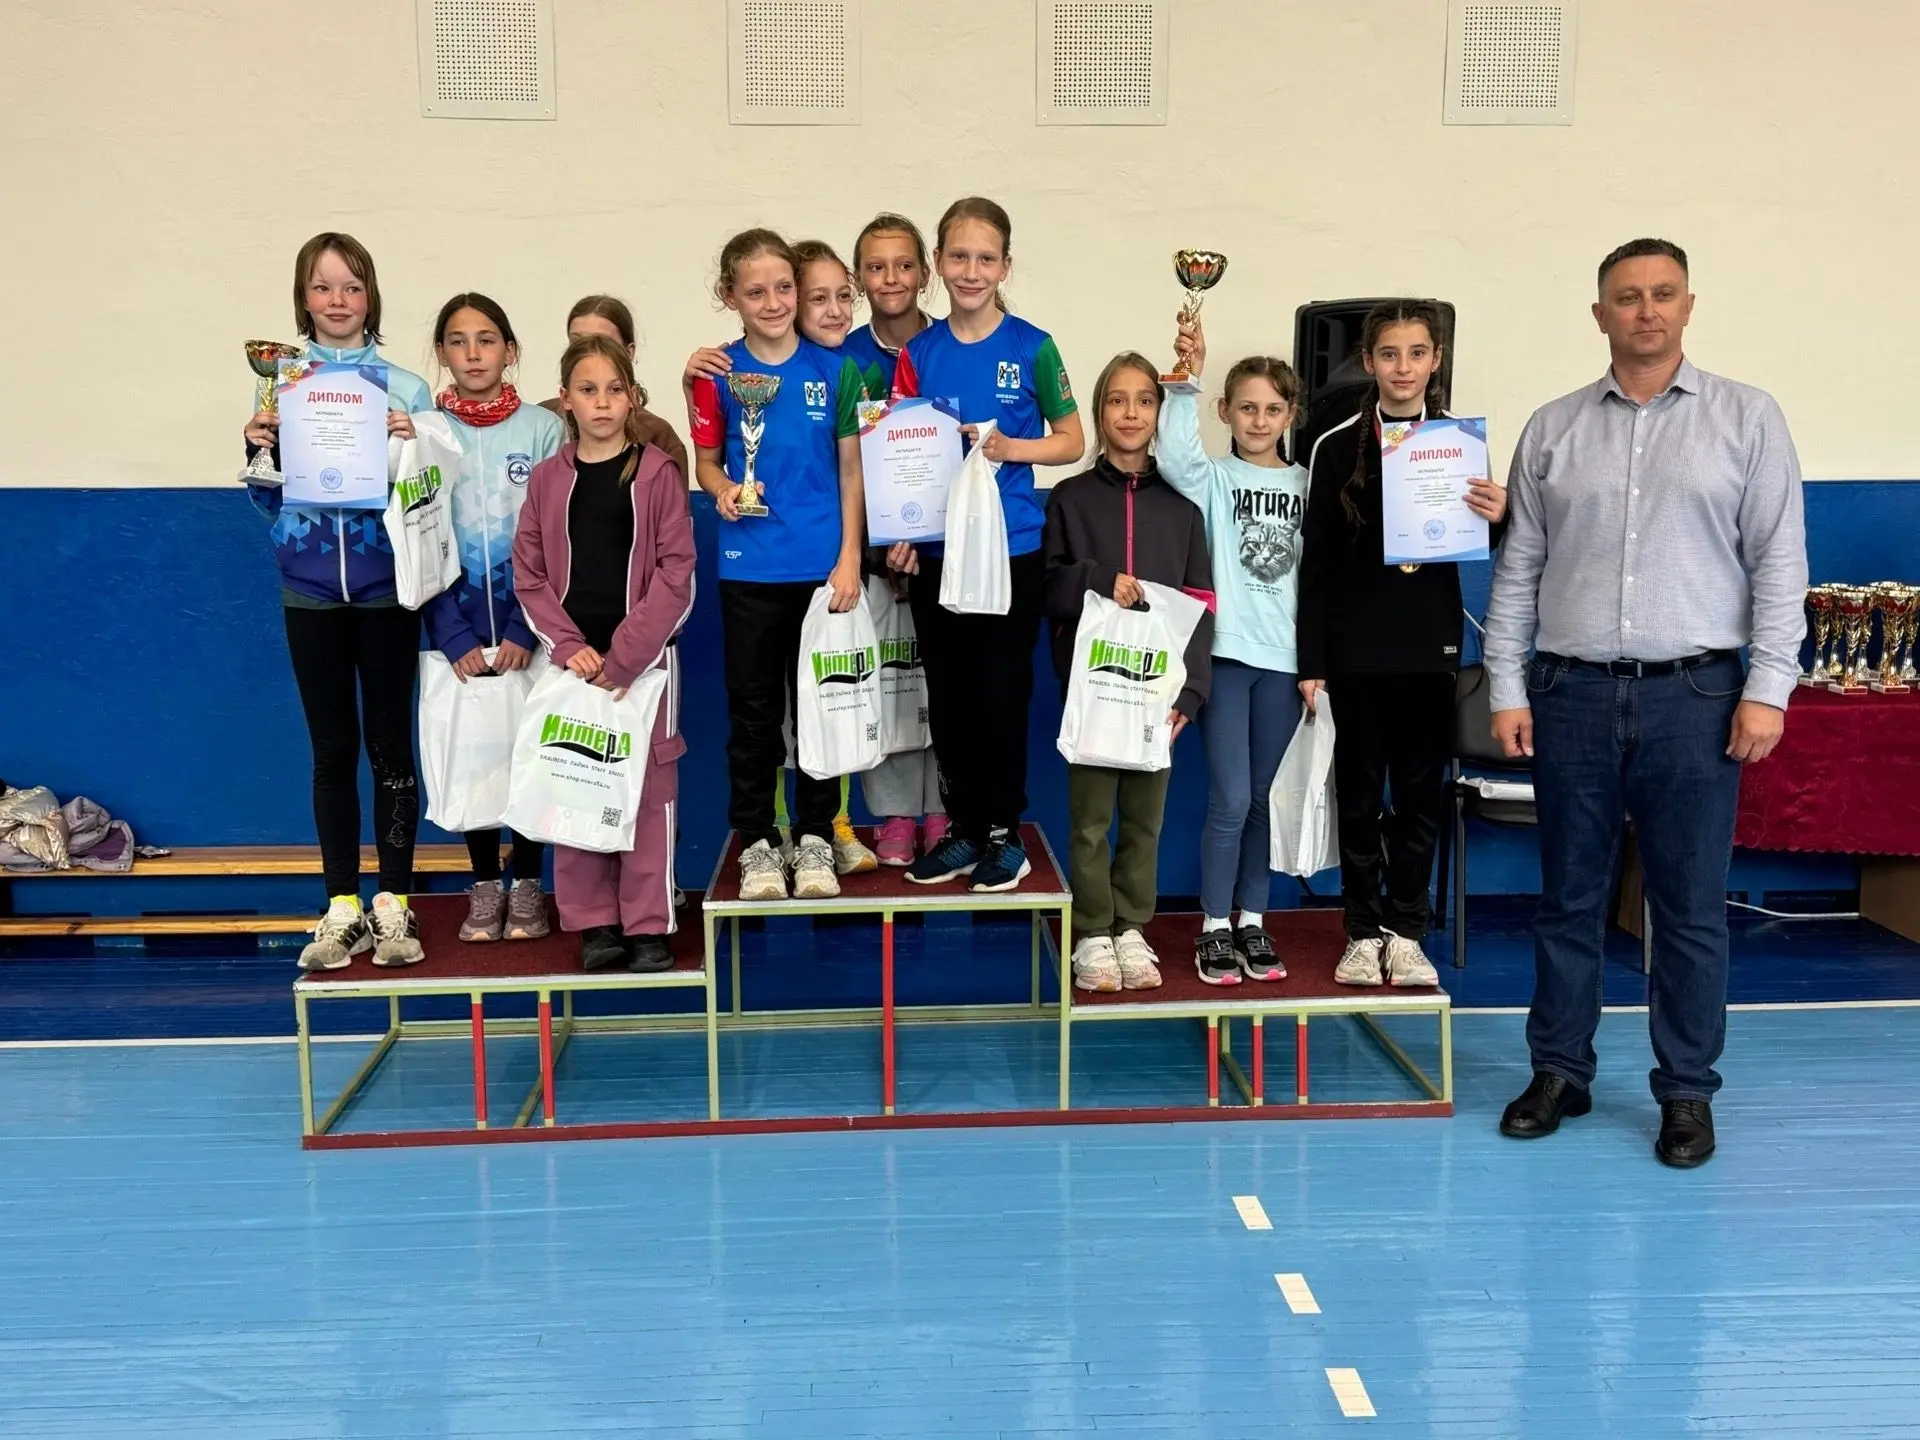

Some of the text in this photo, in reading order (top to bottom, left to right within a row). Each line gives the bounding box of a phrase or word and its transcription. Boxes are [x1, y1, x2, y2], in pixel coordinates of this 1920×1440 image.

[307, 391, 363, 404] ДИПЛОМ
[887, 426, 938, 443] ДИПЛОМ
[1409, 447, 1463, 463] ДИПЛОМ
